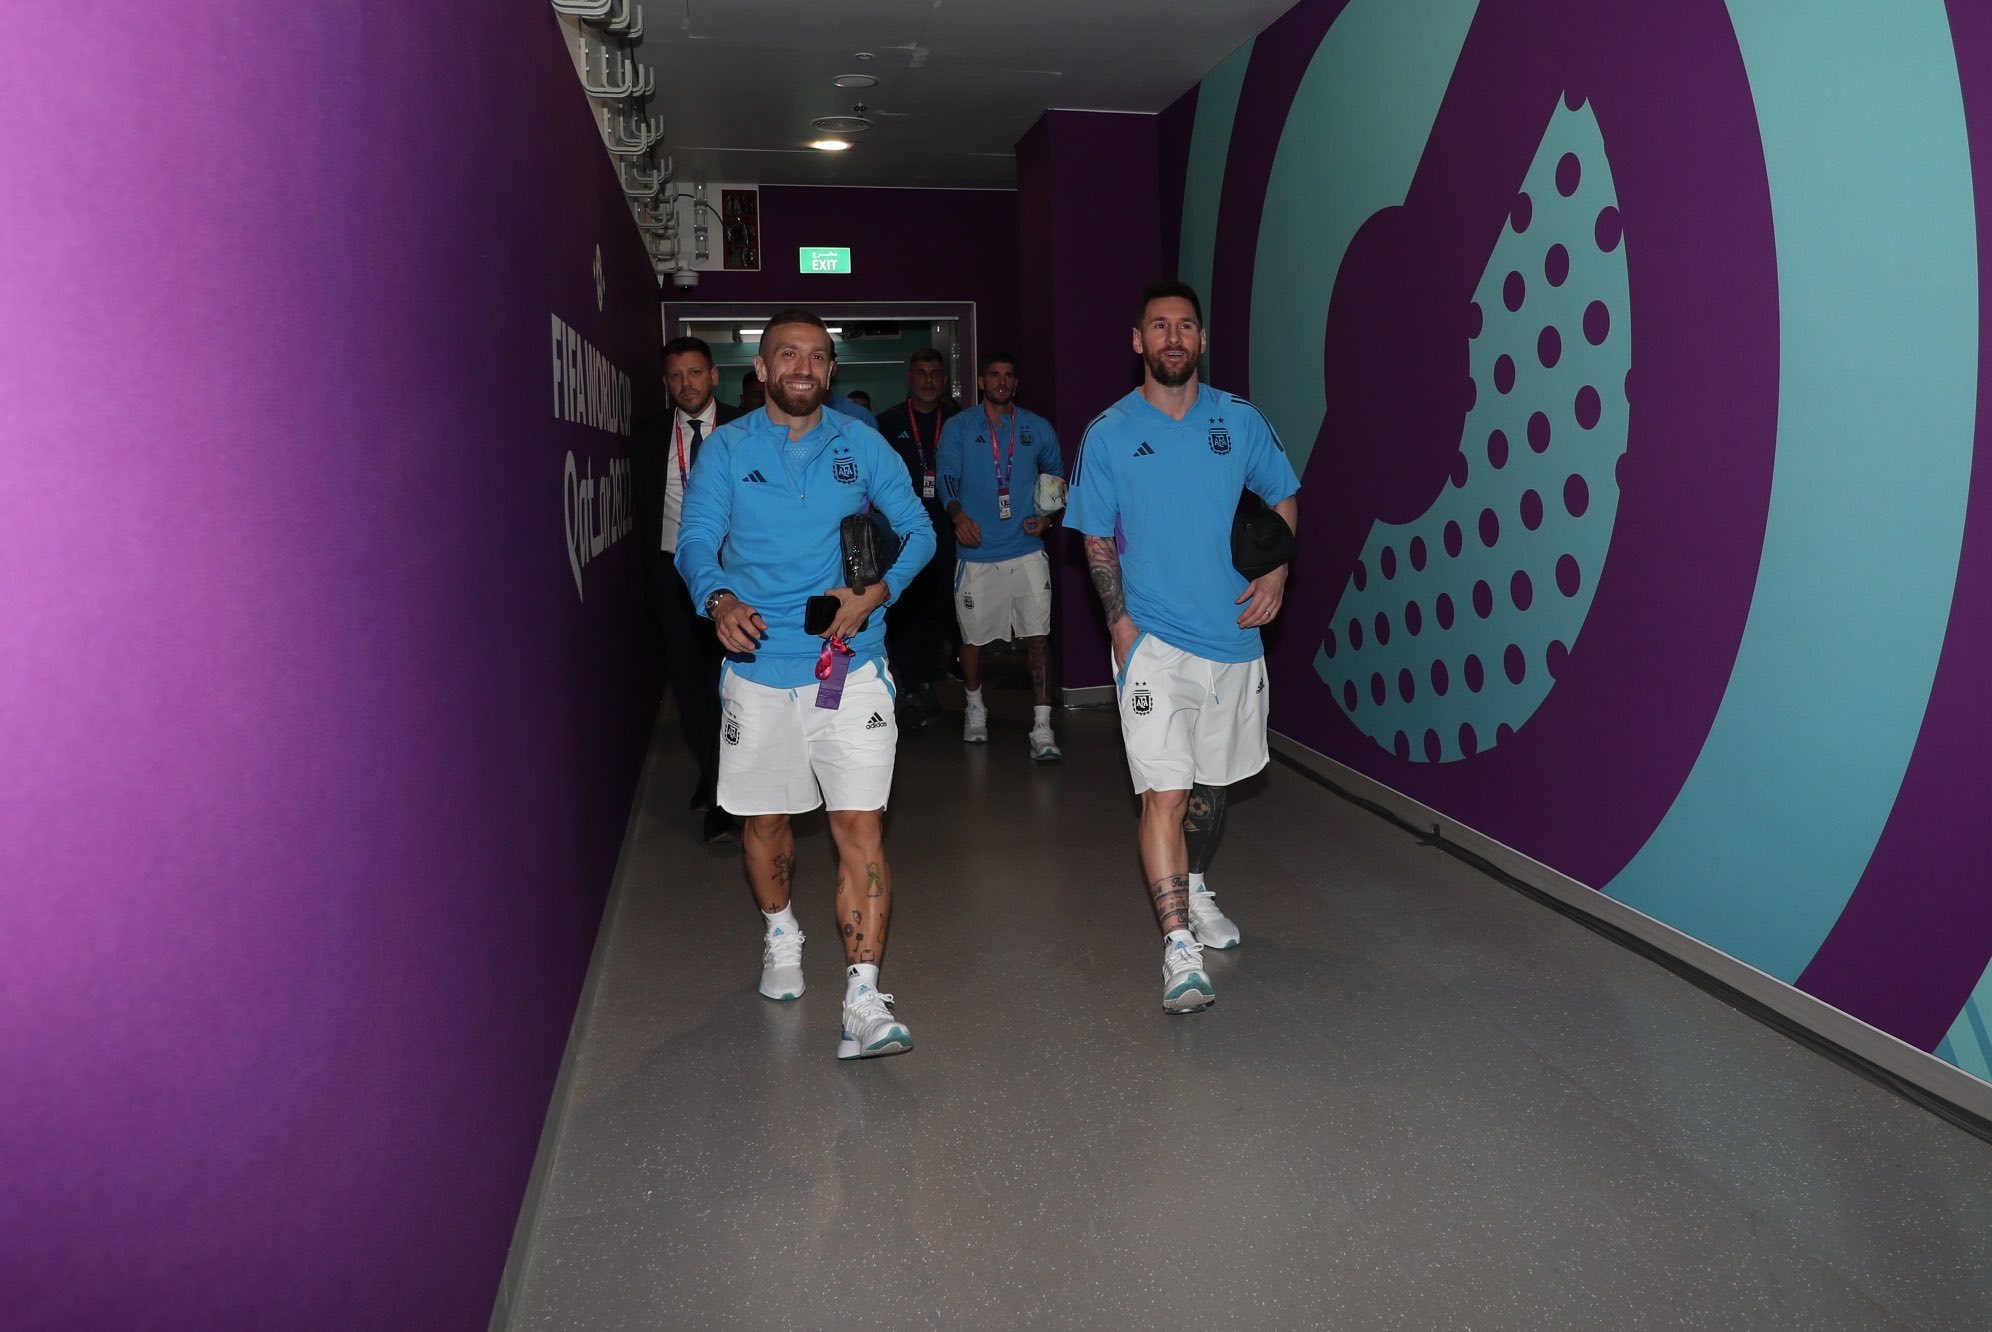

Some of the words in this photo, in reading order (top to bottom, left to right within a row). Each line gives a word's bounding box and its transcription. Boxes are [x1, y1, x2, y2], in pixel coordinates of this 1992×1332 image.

[812, 259, 838, 271] EXIT
[551, 312, 587, 425] FIFA
[584, 339, 619, 434] WORLD
[618, 370, 632, 437] CUP
[564, 450, 611, 603] Qatar
[609, 458, 633, 544] 2022
[866, 721, 887, 730] adidas
